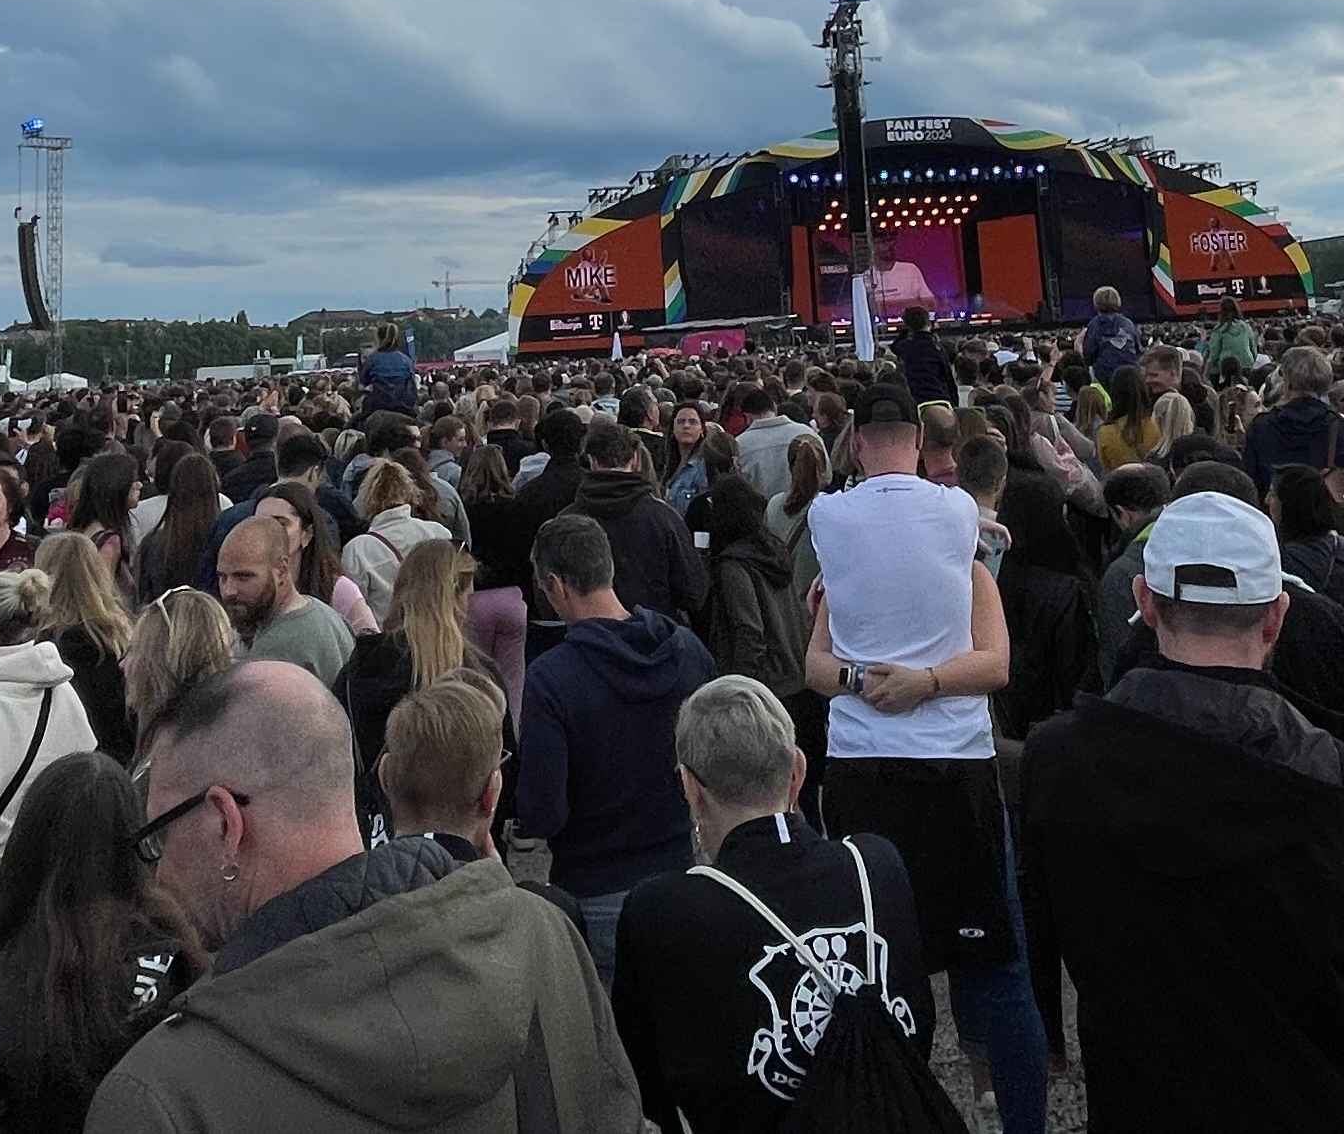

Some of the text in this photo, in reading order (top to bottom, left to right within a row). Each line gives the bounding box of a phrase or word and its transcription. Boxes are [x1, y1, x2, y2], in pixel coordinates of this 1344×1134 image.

[886, 118, 952, 131] FAN FEST
[1190, 232, 1247, 253] FOSTER
[566, 266, 617, 288] MIKE
